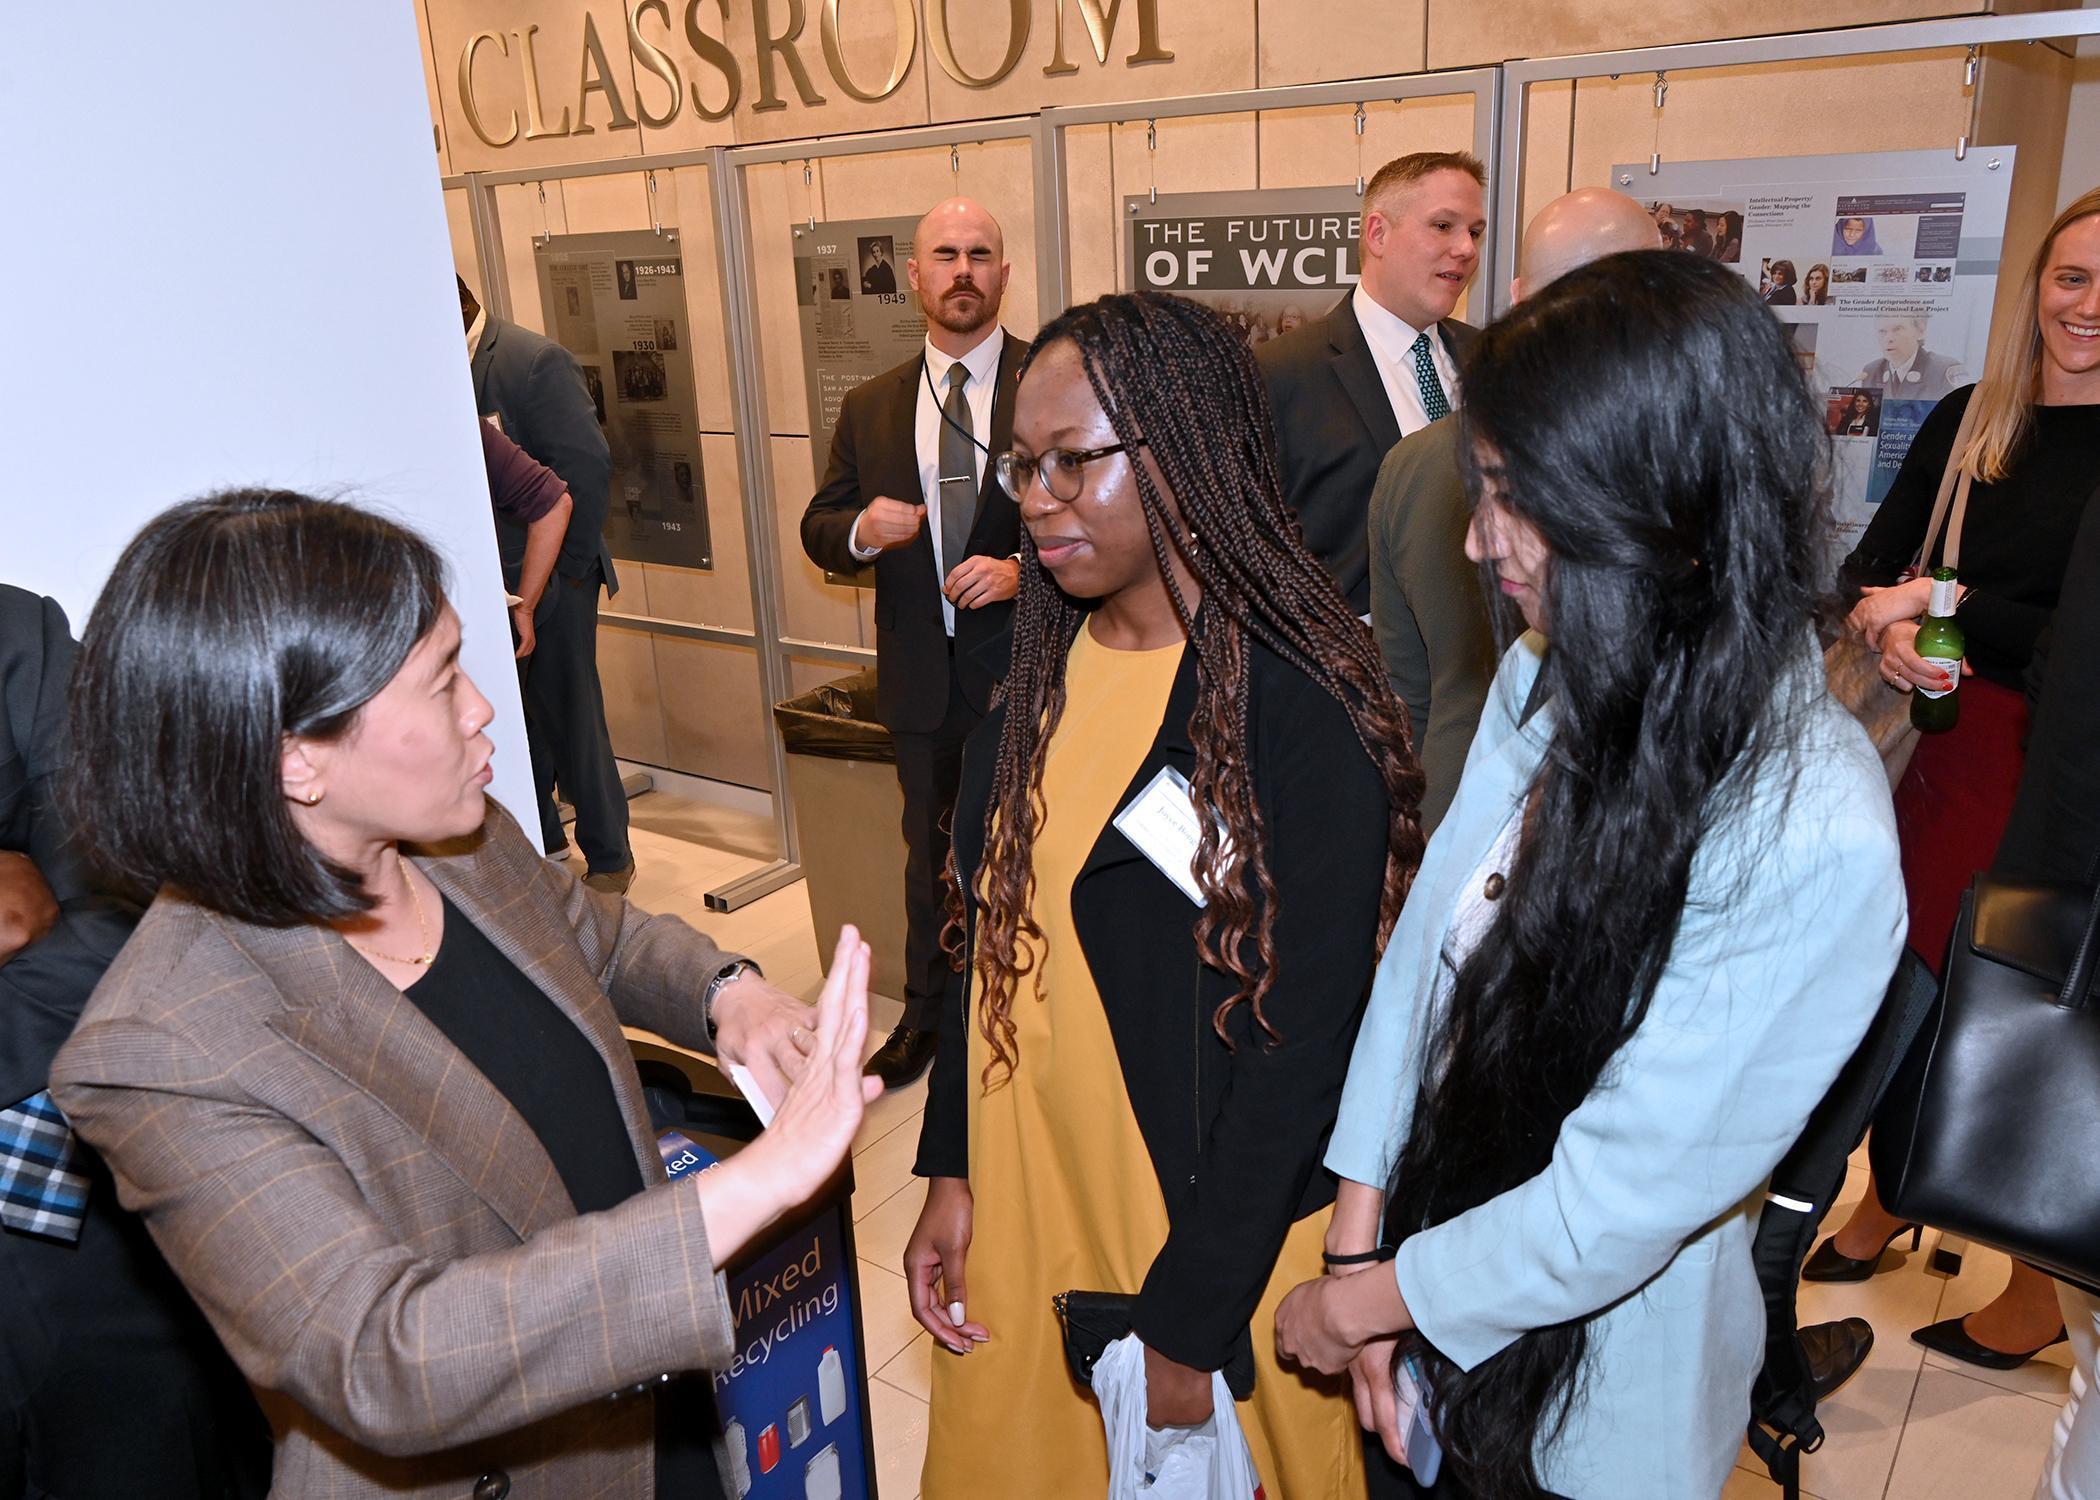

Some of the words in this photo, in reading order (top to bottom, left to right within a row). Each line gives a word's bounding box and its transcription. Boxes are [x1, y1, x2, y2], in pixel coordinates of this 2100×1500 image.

[458, 0, 1176, 147] CLASSROOM
[1749, 196, 1783, 204] Intellectual
[1784, 195, 1814, 204] Property/
[1773, 202, 1800, 211] Mapping
[1144, 222, 1206, 244] THE
[1227, 217, 1362, 242] FUTURE
[816, 245, 837, 254] 1937
[634, 264, 676, 276] 1926-1943
[1145, 250, 1213, 286] OF
[1239, 247, 1362, 286] WCL
[877, 293, 906, 304] 1949
[632, 340, 655, 350] 1930
[1881, 431, 1907, 441] Gender
[1878, 460, 1891, 469] and
[661, 521, 681, 531] 1943
[664, 1149, 699, 1179] xed
